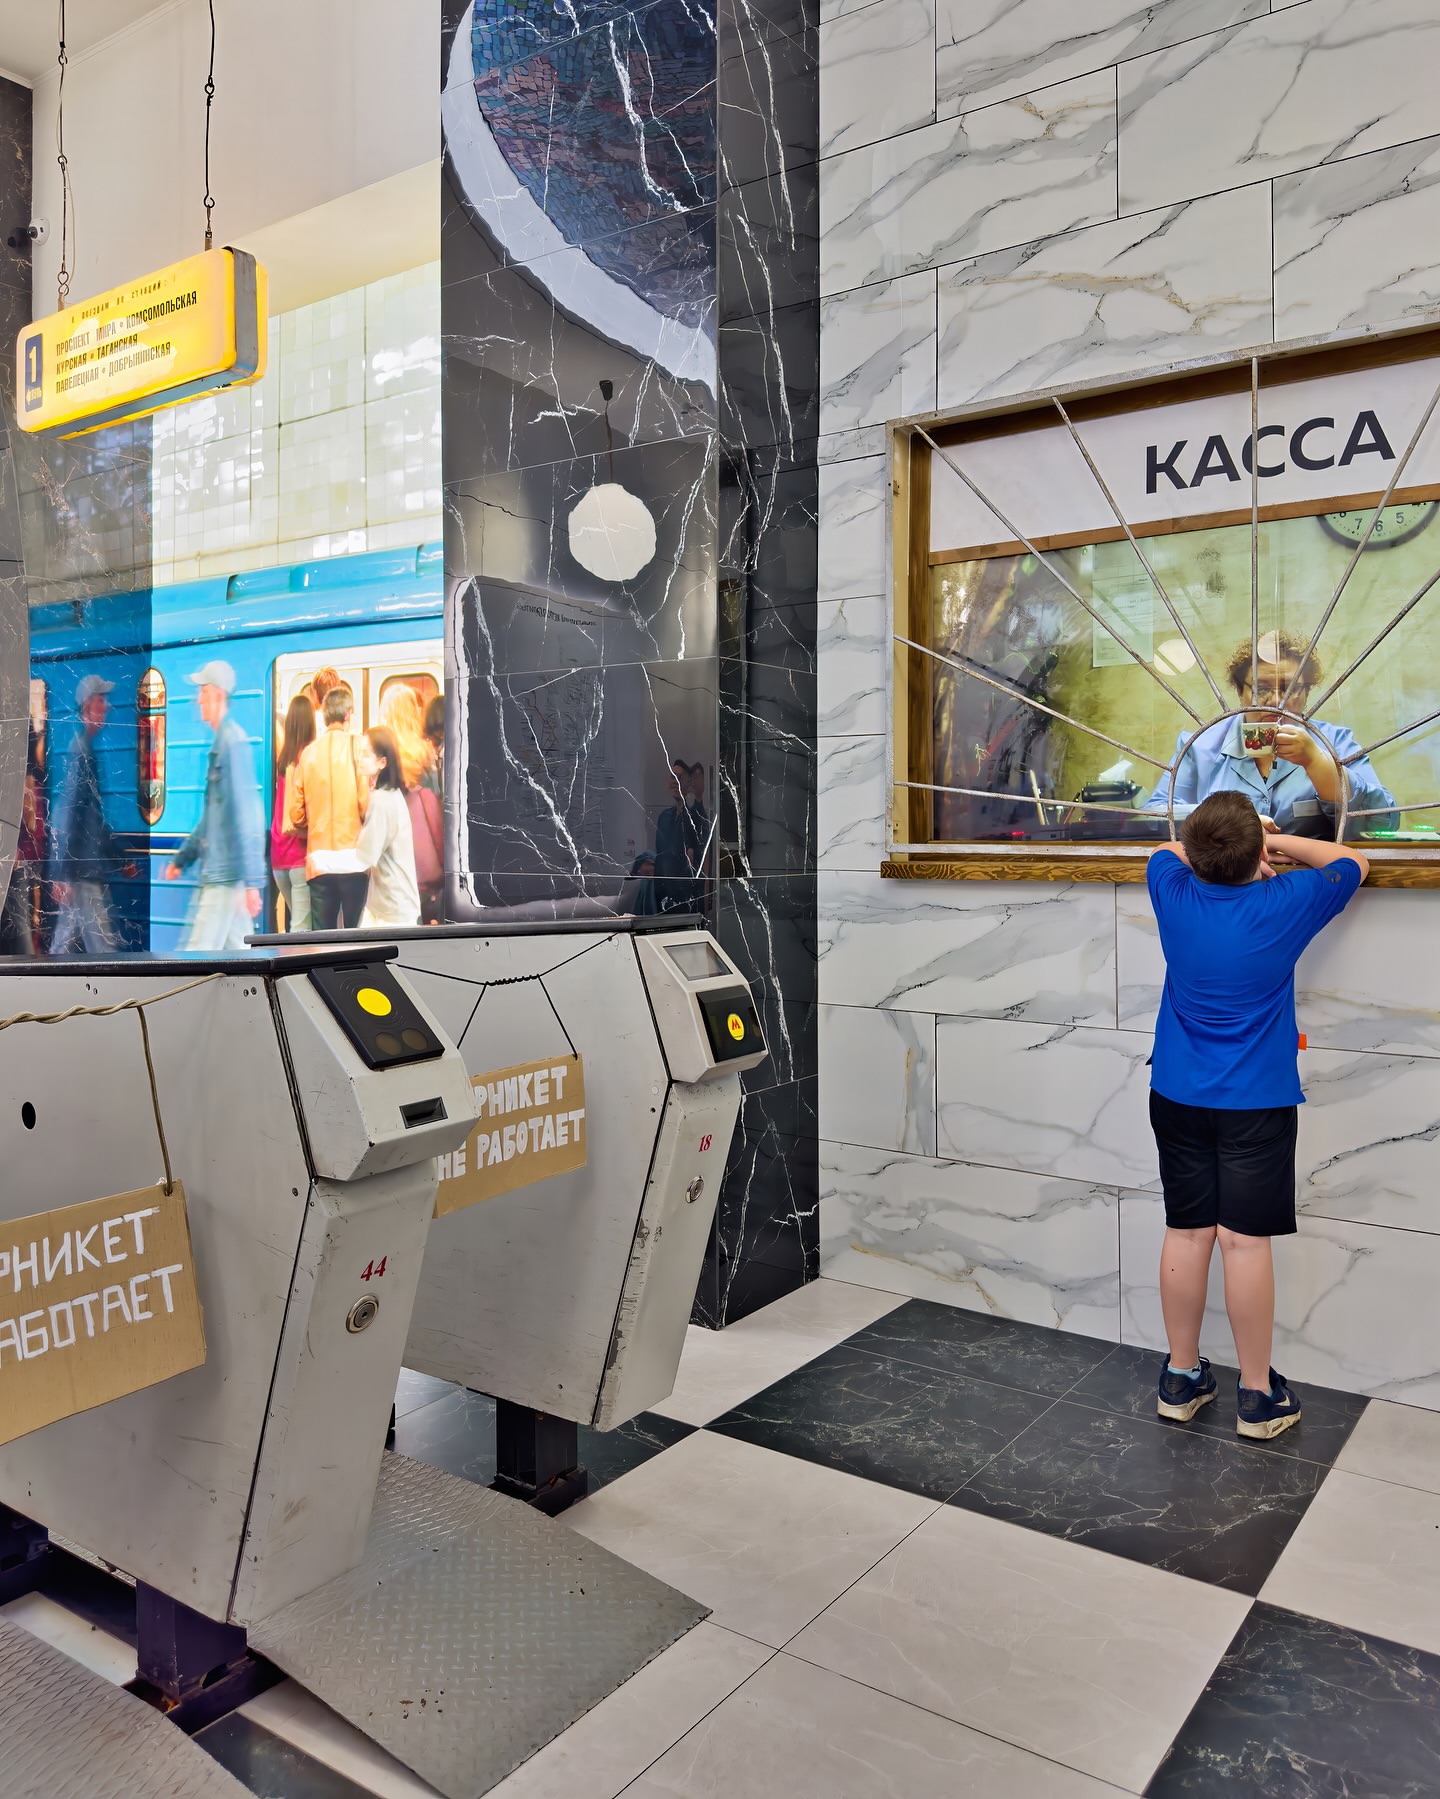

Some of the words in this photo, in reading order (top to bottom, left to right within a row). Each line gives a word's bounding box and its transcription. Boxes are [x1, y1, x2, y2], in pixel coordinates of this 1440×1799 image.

[56, 332, 90, 357] ПРОСПЕКТ
[96, 321, 117, 342] МИРА
[126, 290, 197, 329] КОМСОМОЛЬСКАЯ
[29, 345, 37, 383] 1
[56, 353, 87, 375] КУРСКАЯ
[97, 333, 138, 360] ТАГАНСКАЯ
[1146, 410, 1396, 494] КАССА
[1354, 518, 1363, 530] 7
[1375, 520, 1384, 532] 6
[1395, 512, 1405, 524] 5
[437, 1141, 466, 1182] НЕ
[477, 1108, 585, 1170] РАБОТАЕТ
[698, 1134, 713, 1153] 18
[360, 1255, 388, 1282] 44
